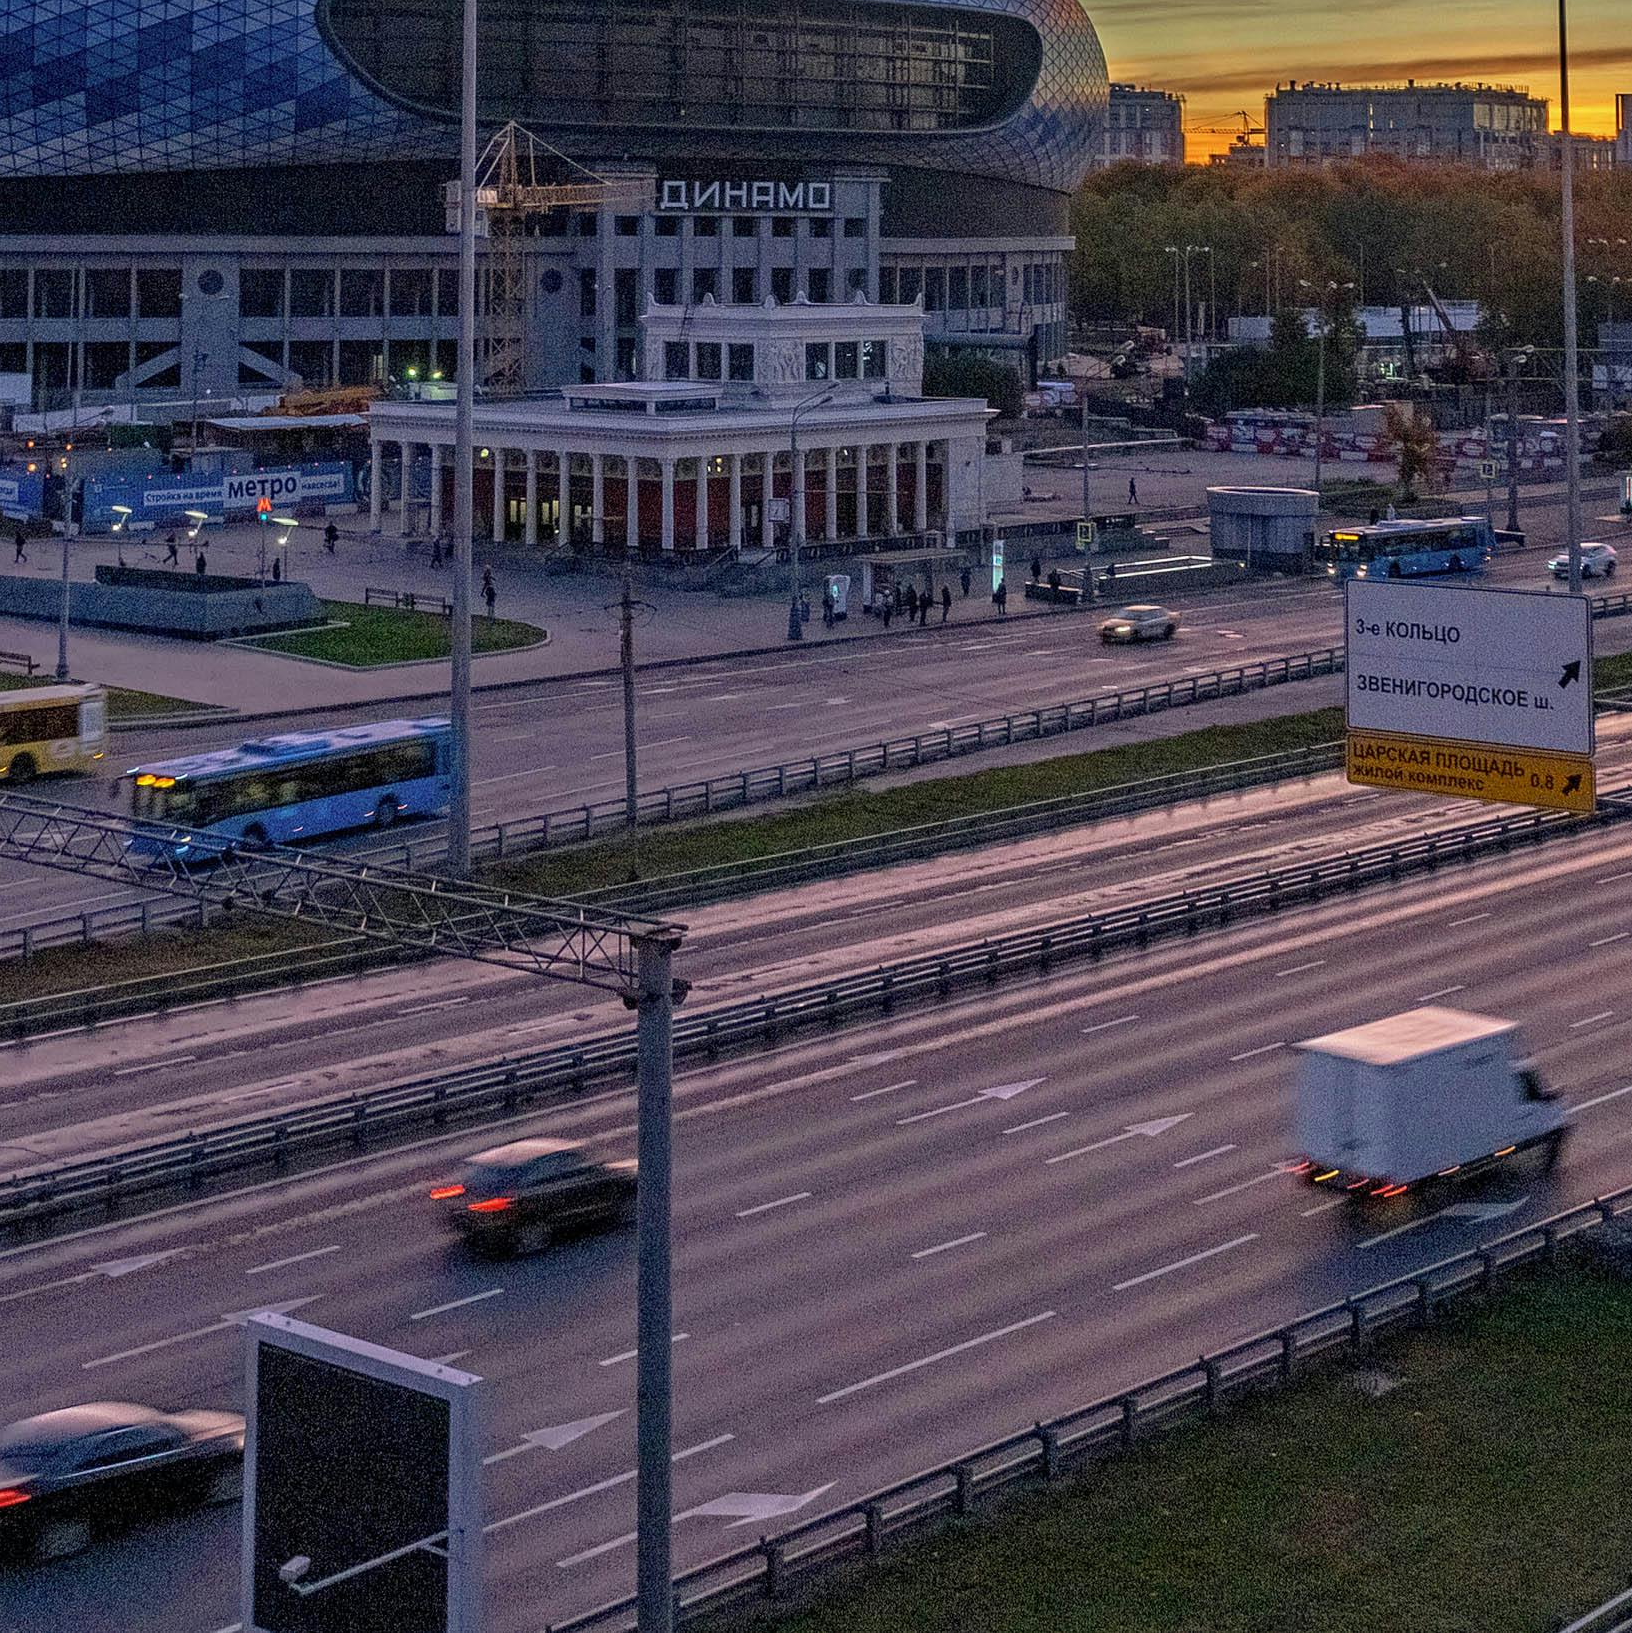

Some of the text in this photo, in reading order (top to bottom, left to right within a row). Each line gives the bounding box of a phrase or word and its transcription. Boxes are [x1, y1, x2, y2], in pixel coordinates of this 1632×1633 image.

[659, 180, 830, 210] ДИНАМО
[228, 476, 297, 501] метро
[1356, 618, 1461, 645] 3-е КОЛЬЦО
[1356, 673, 1555, 711] ЗВЕНИГОРОДСКОЕ ш.
[1352, 741, 1525, 779] ЦАРСКАЯ ПЛОЩАДЬ
[1352, 762, 1485, 792] жилой комплекс
[1530, 773, 1555, 791] 0.8
